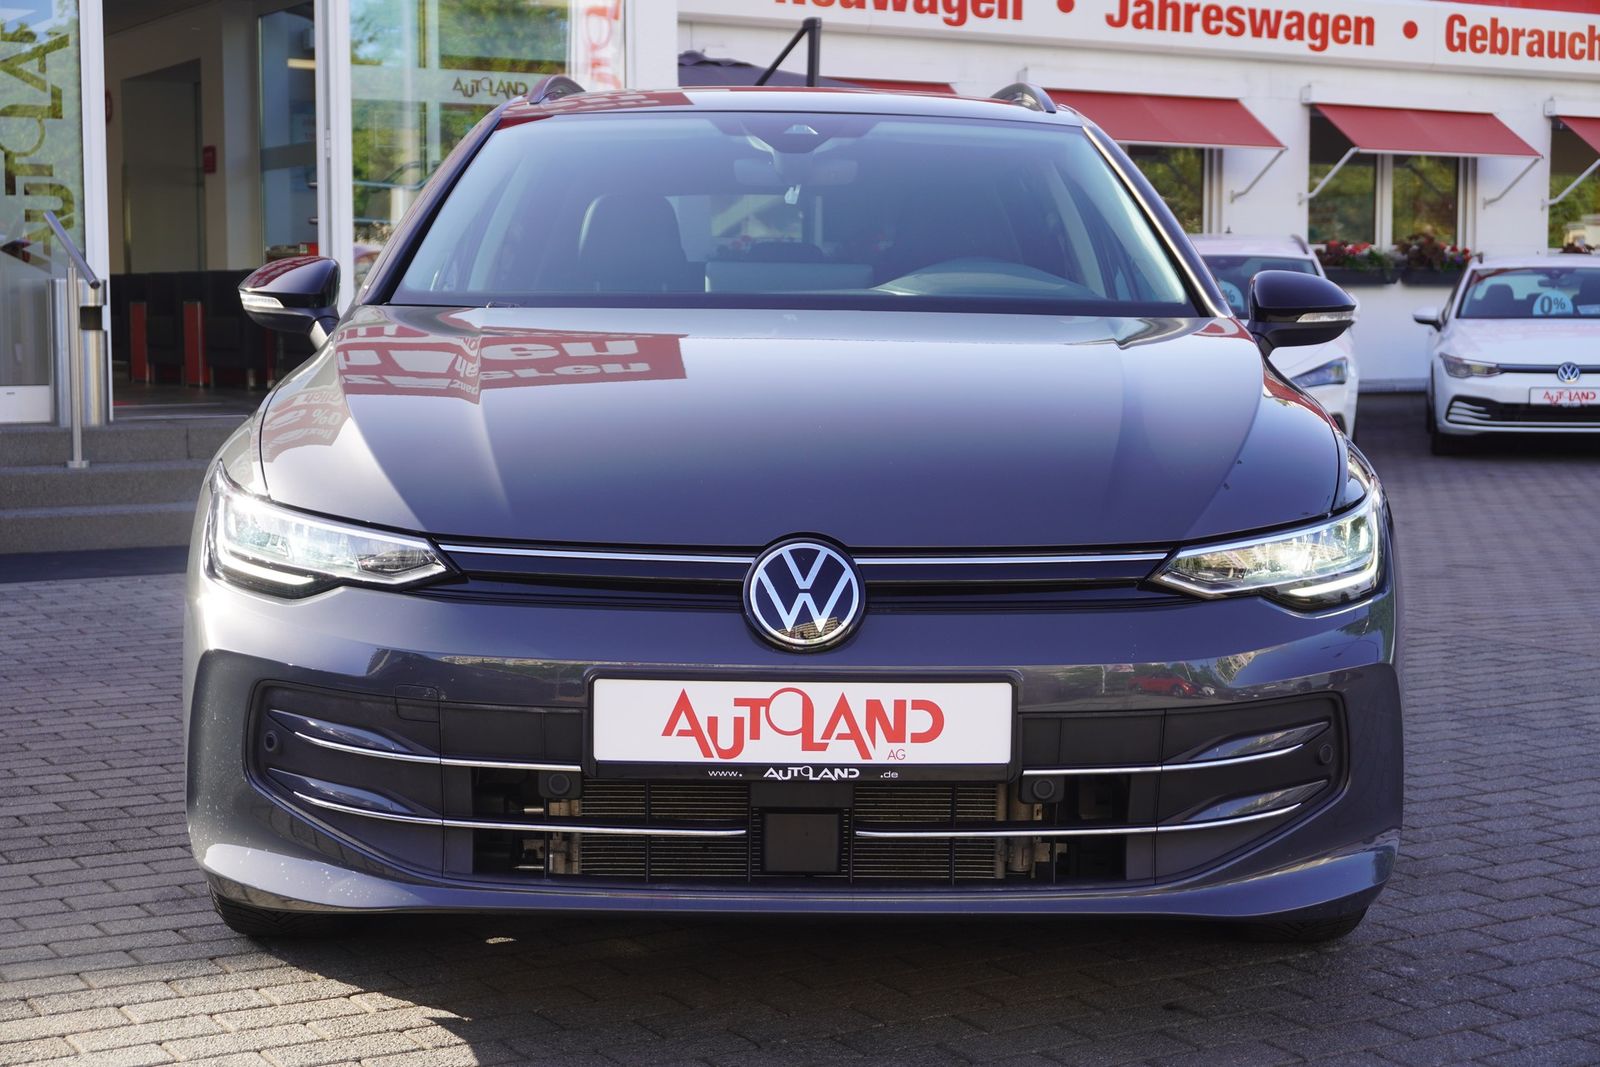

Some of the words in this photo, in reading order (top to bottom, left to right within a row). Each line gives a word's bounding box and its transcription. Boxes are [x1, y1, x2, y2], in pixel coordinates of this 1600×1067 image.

[1105, 0, 1375, 52] Jahreswagen
[1445, 13, 1600, 62] Gebrauch
[453, 76, 528, 99] AUTOLAND
[1540, 295, 1566, 315] 0%
[1543, 390, 1597, 405] AUTOLAND
[661, 687, 945, 760] AUTOLAND
[887, 749, 906, 761] AG
[708, 769, 743, 777] www.
[763, 765, 860, 781] AUTOLAND
[880, 770, 899, 778] .de
